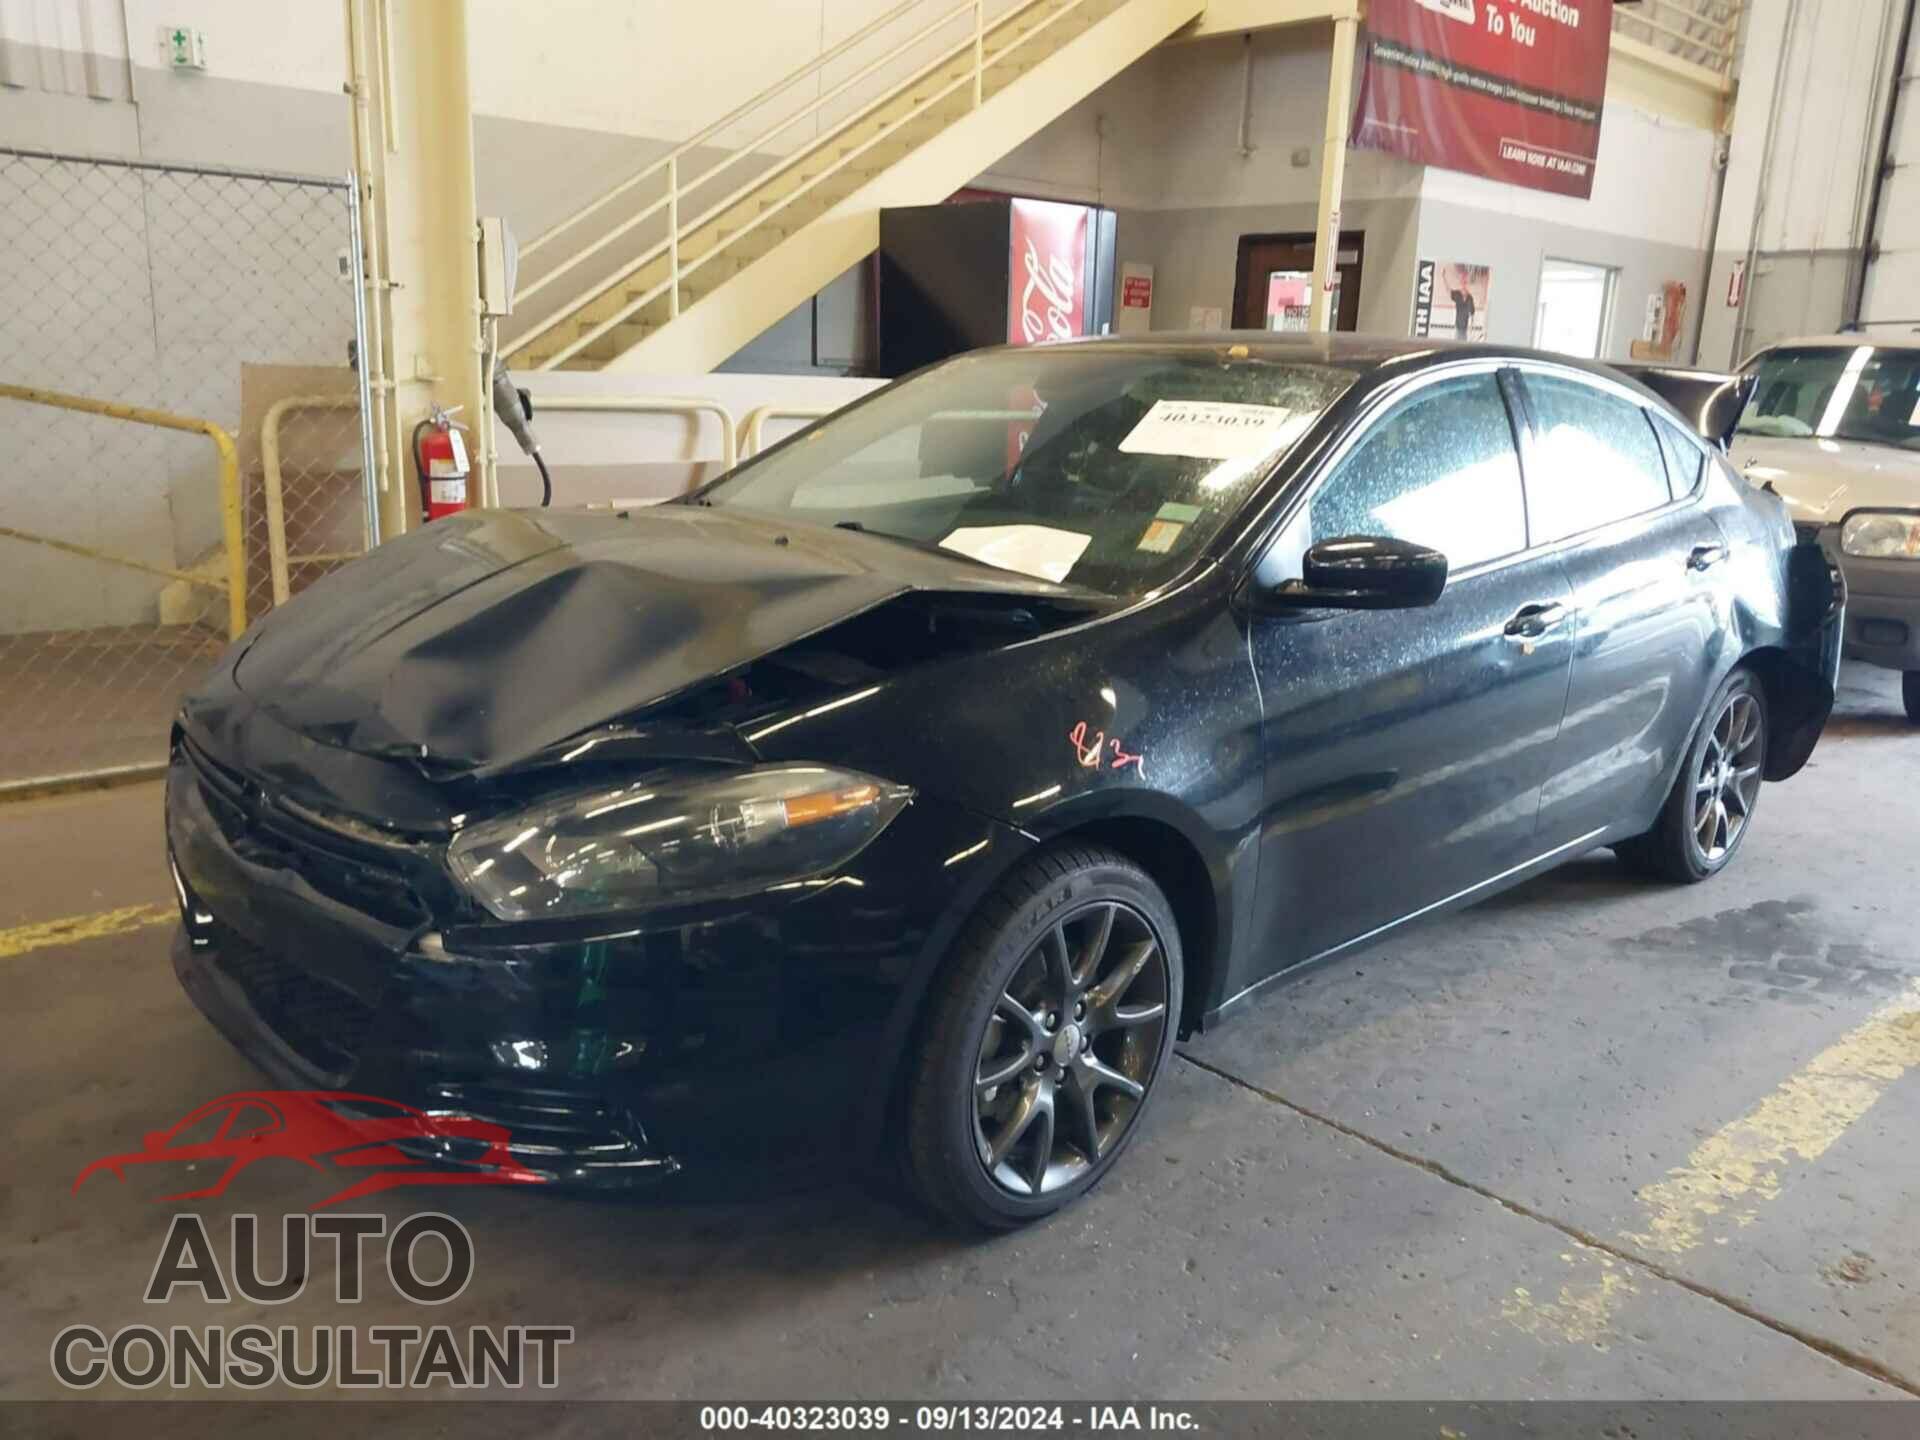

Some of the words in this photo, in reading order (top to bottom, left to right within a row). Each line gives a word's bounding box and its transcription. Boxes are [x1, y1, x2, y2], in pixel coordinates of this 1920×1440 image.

[1486, 5, 1504, 36] To
[1509, 12, 1536, 48] You
[1545, 156, 1558, 171] AT
[1418, 266, 1433, 303] IAA
